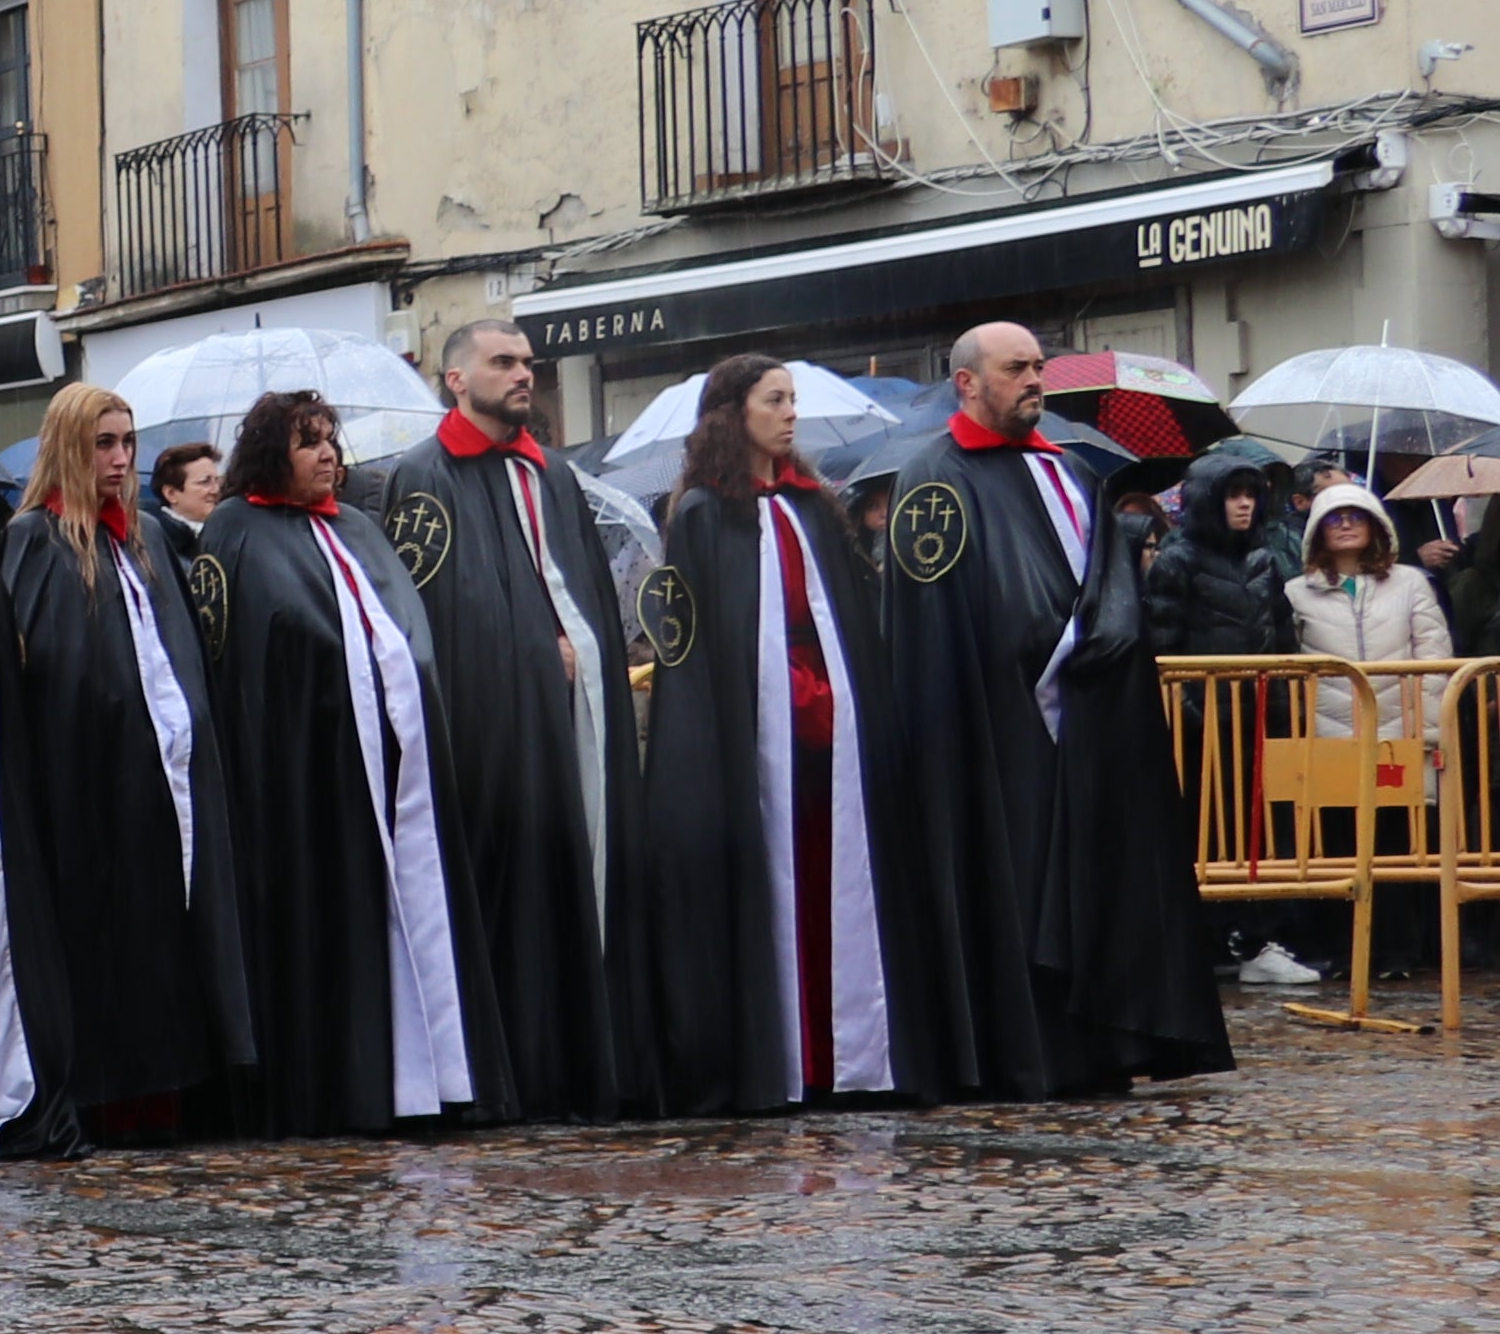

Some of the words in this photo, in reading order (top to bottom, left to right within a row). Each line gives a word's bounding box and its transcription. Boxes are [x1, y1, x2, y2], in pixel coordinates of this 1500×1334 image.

[1137, 222, 1162, 257] LA
[1169, 203, 1272, 263] GENUINA
[488, 280, 503, 297] 12
[545, 308, 665, 346] TABERNA
